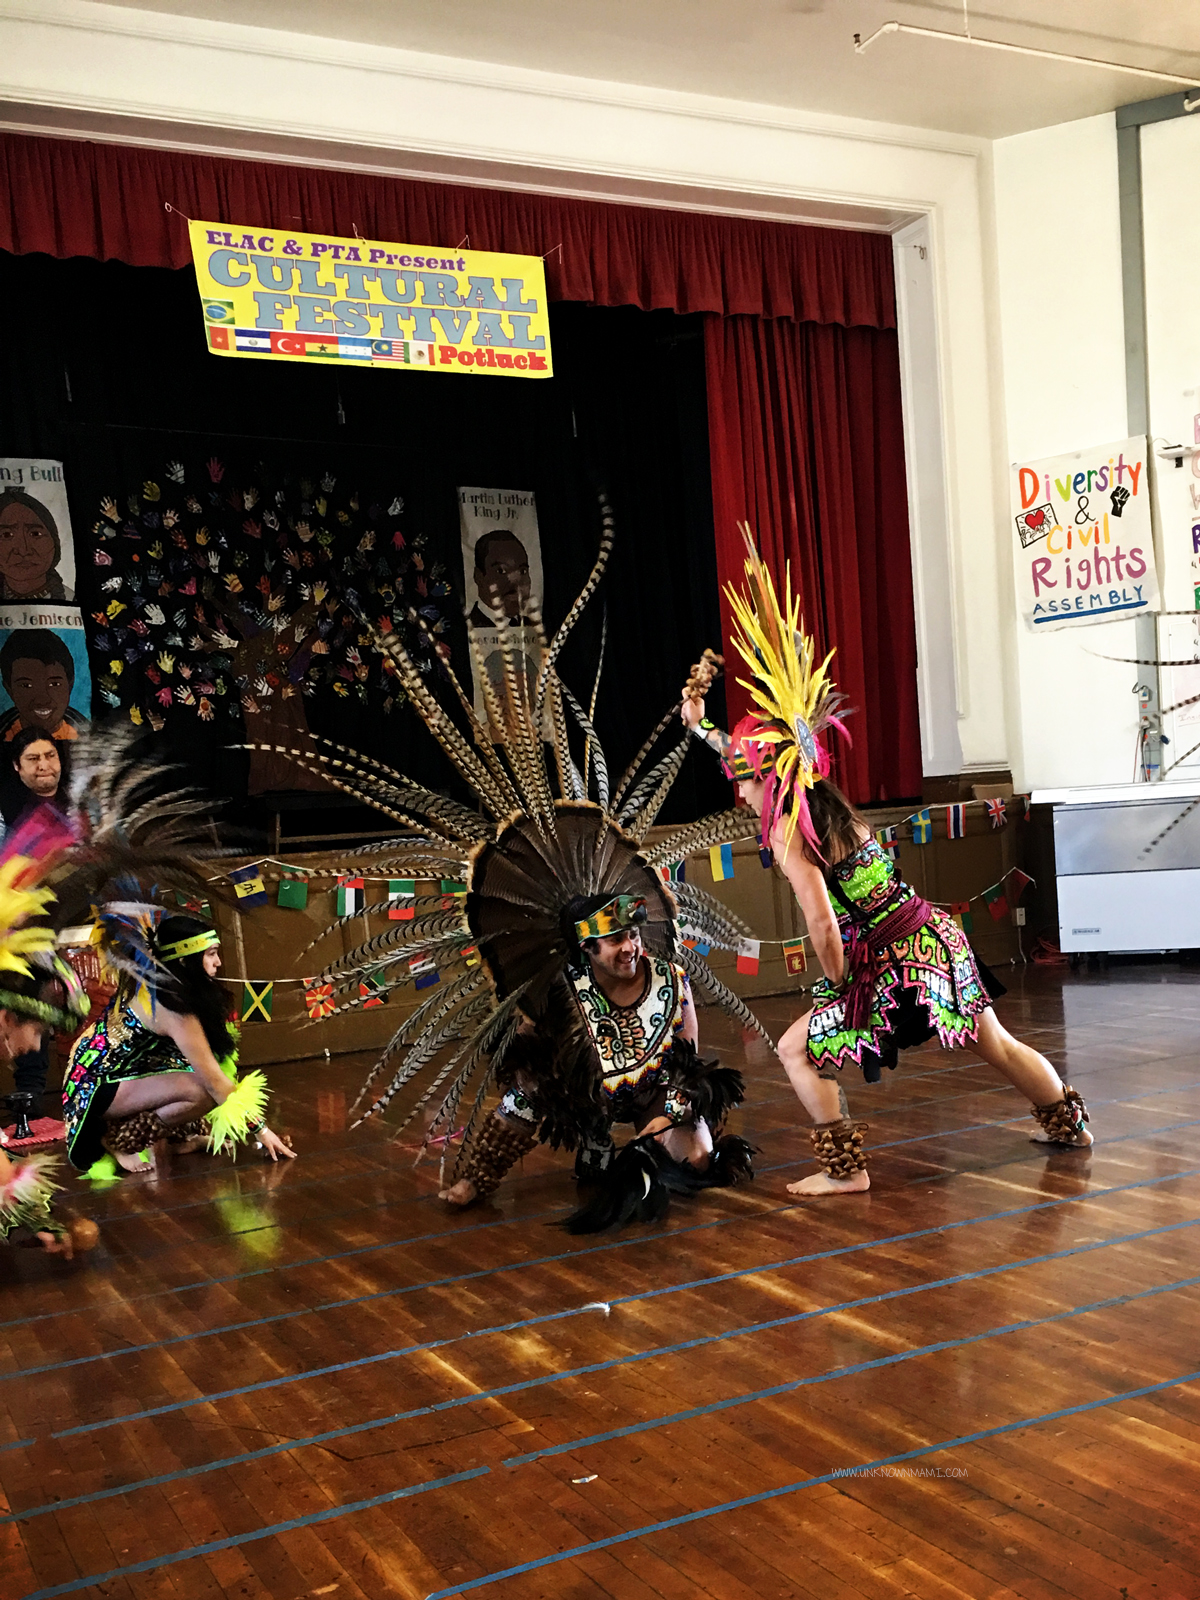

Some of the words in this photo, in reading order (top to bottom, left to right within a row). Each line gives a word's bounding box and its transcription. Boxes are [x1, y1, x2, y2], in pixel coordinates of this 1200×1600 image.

[206, 229, 275, 253] ELAC
[282, 241, 303, 256] &
[311, 243, 362, 262] PTA
[369, 248, 466, 272] Present
[208, 249, 538, 314] CULTURAL
[253, 291, 546, 350] FESTIVAL
[438, 345, 548, 371] Potluck
[30, 465, 62, 482] Bull
[1019, 453, 1142, 510] Diversity
[474, 505, 500, 521] King
[1074, 496, 1096, 525] &
[1046, 512, 1110, 554] Civil
[1031, 545, 1147, 597] Rights
[1033, 585, 1143, 615] ASSEMBLY
[18, 612, 83, 627] Jemison
